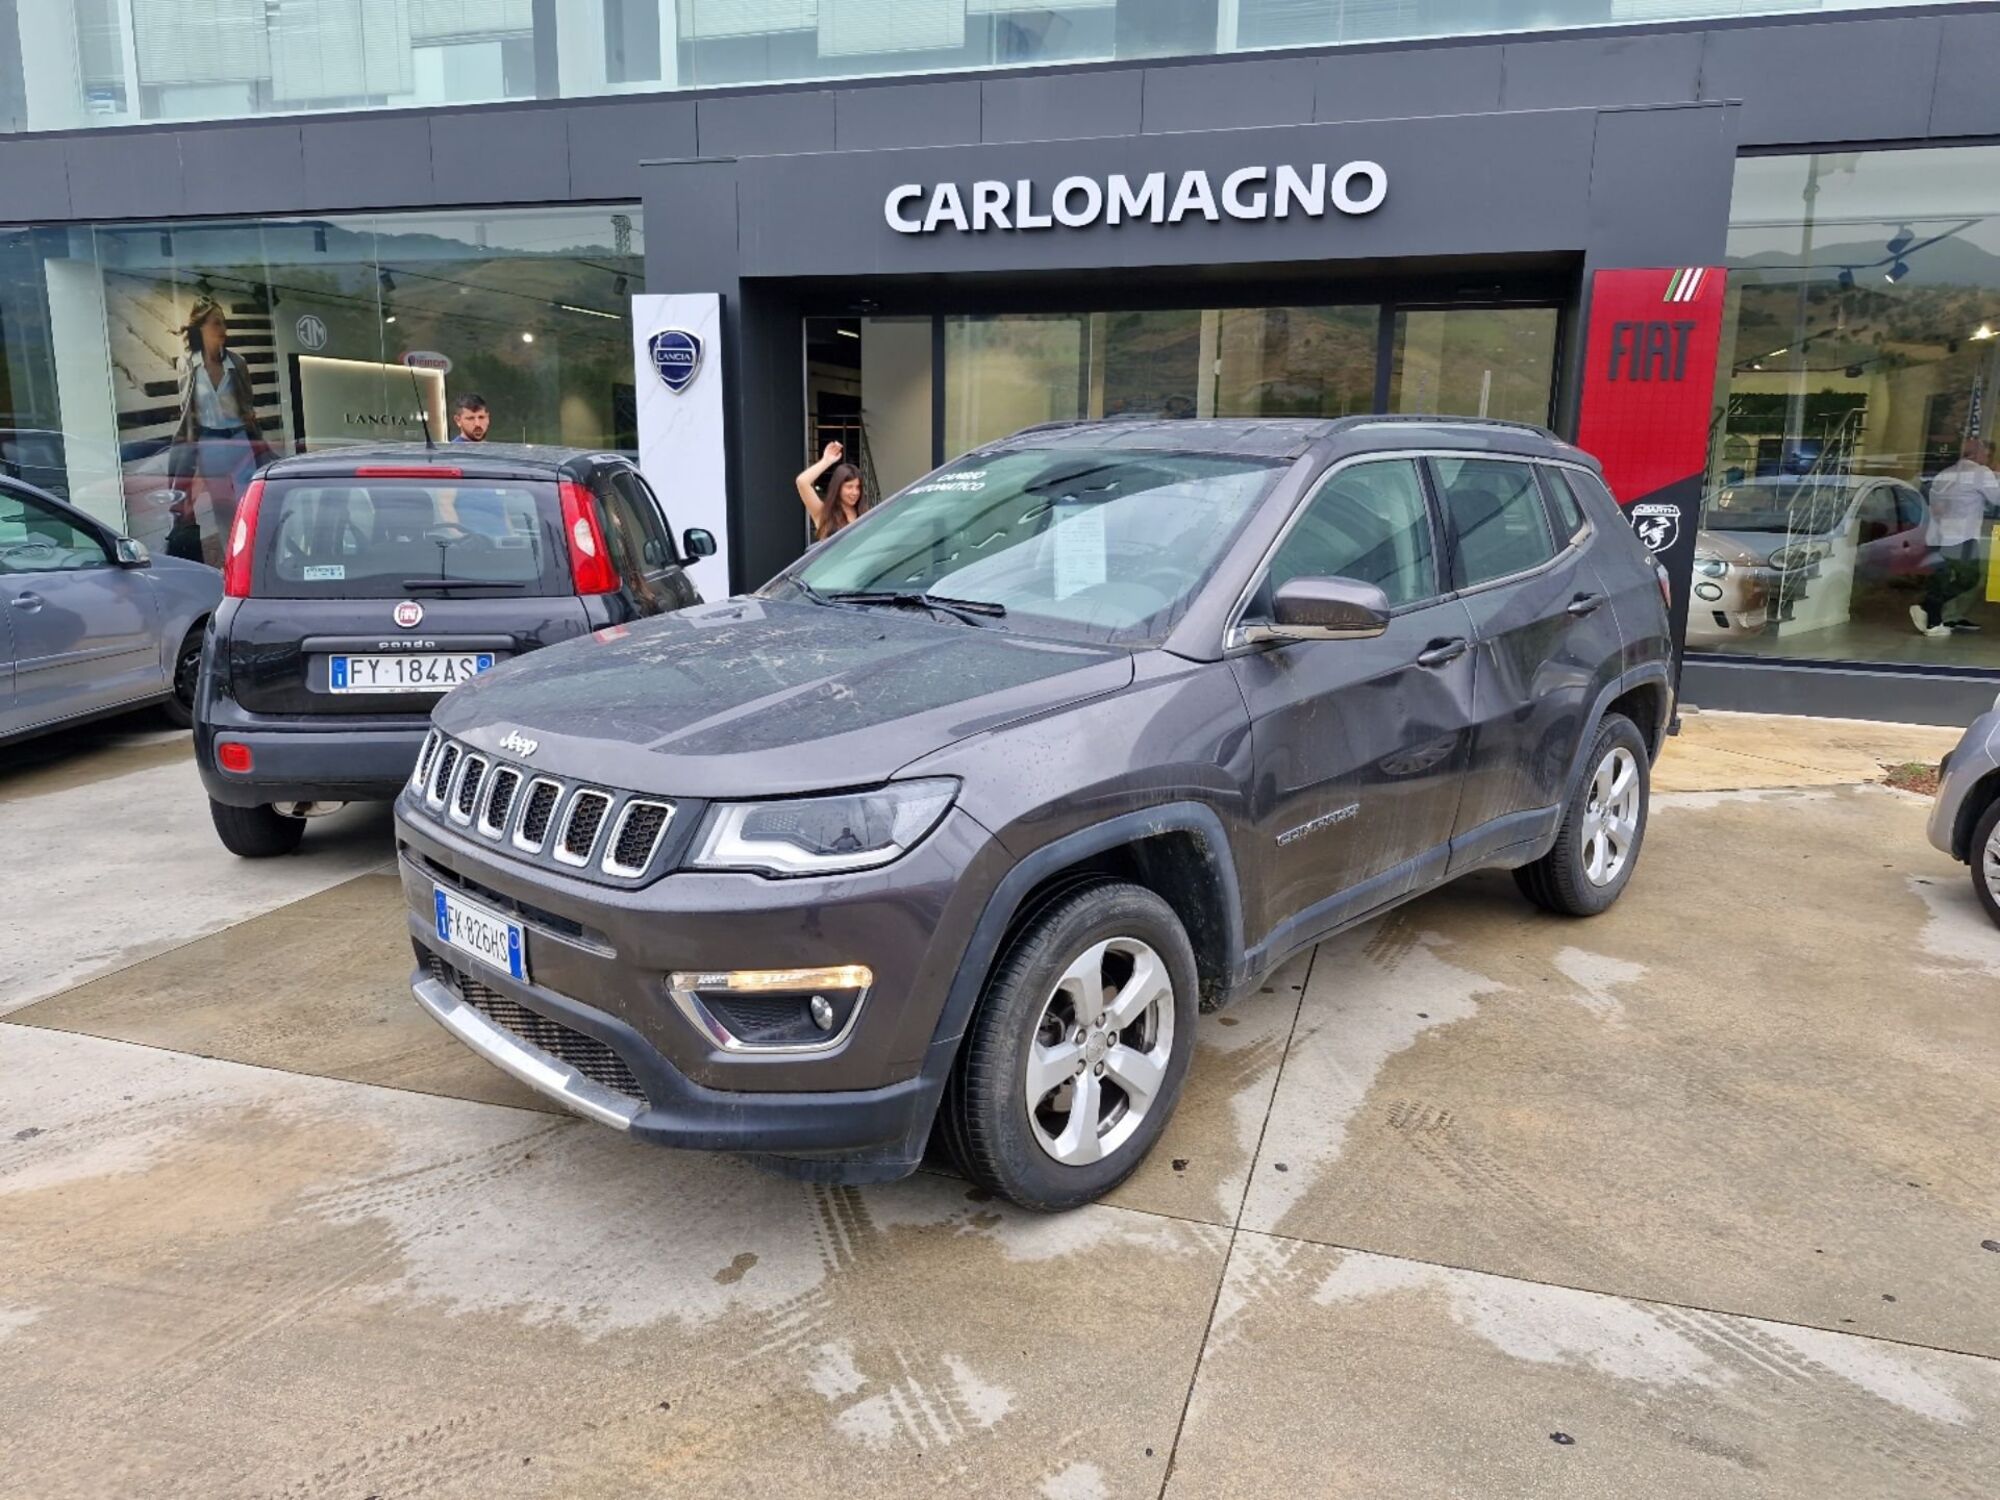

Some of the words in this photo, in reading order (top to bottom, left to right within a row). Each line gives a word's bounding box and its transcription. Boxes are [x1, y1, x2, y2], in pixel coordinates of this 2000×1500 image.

[884, 160, 1388, 232] CARLOMAGNO
[657, 352, 691, 361] LANCIA
[1607, 320, 1696, 382] FIAT
[345, 413, 408, 426] LANCIA
[499, 730, 538, 758] Jeep
